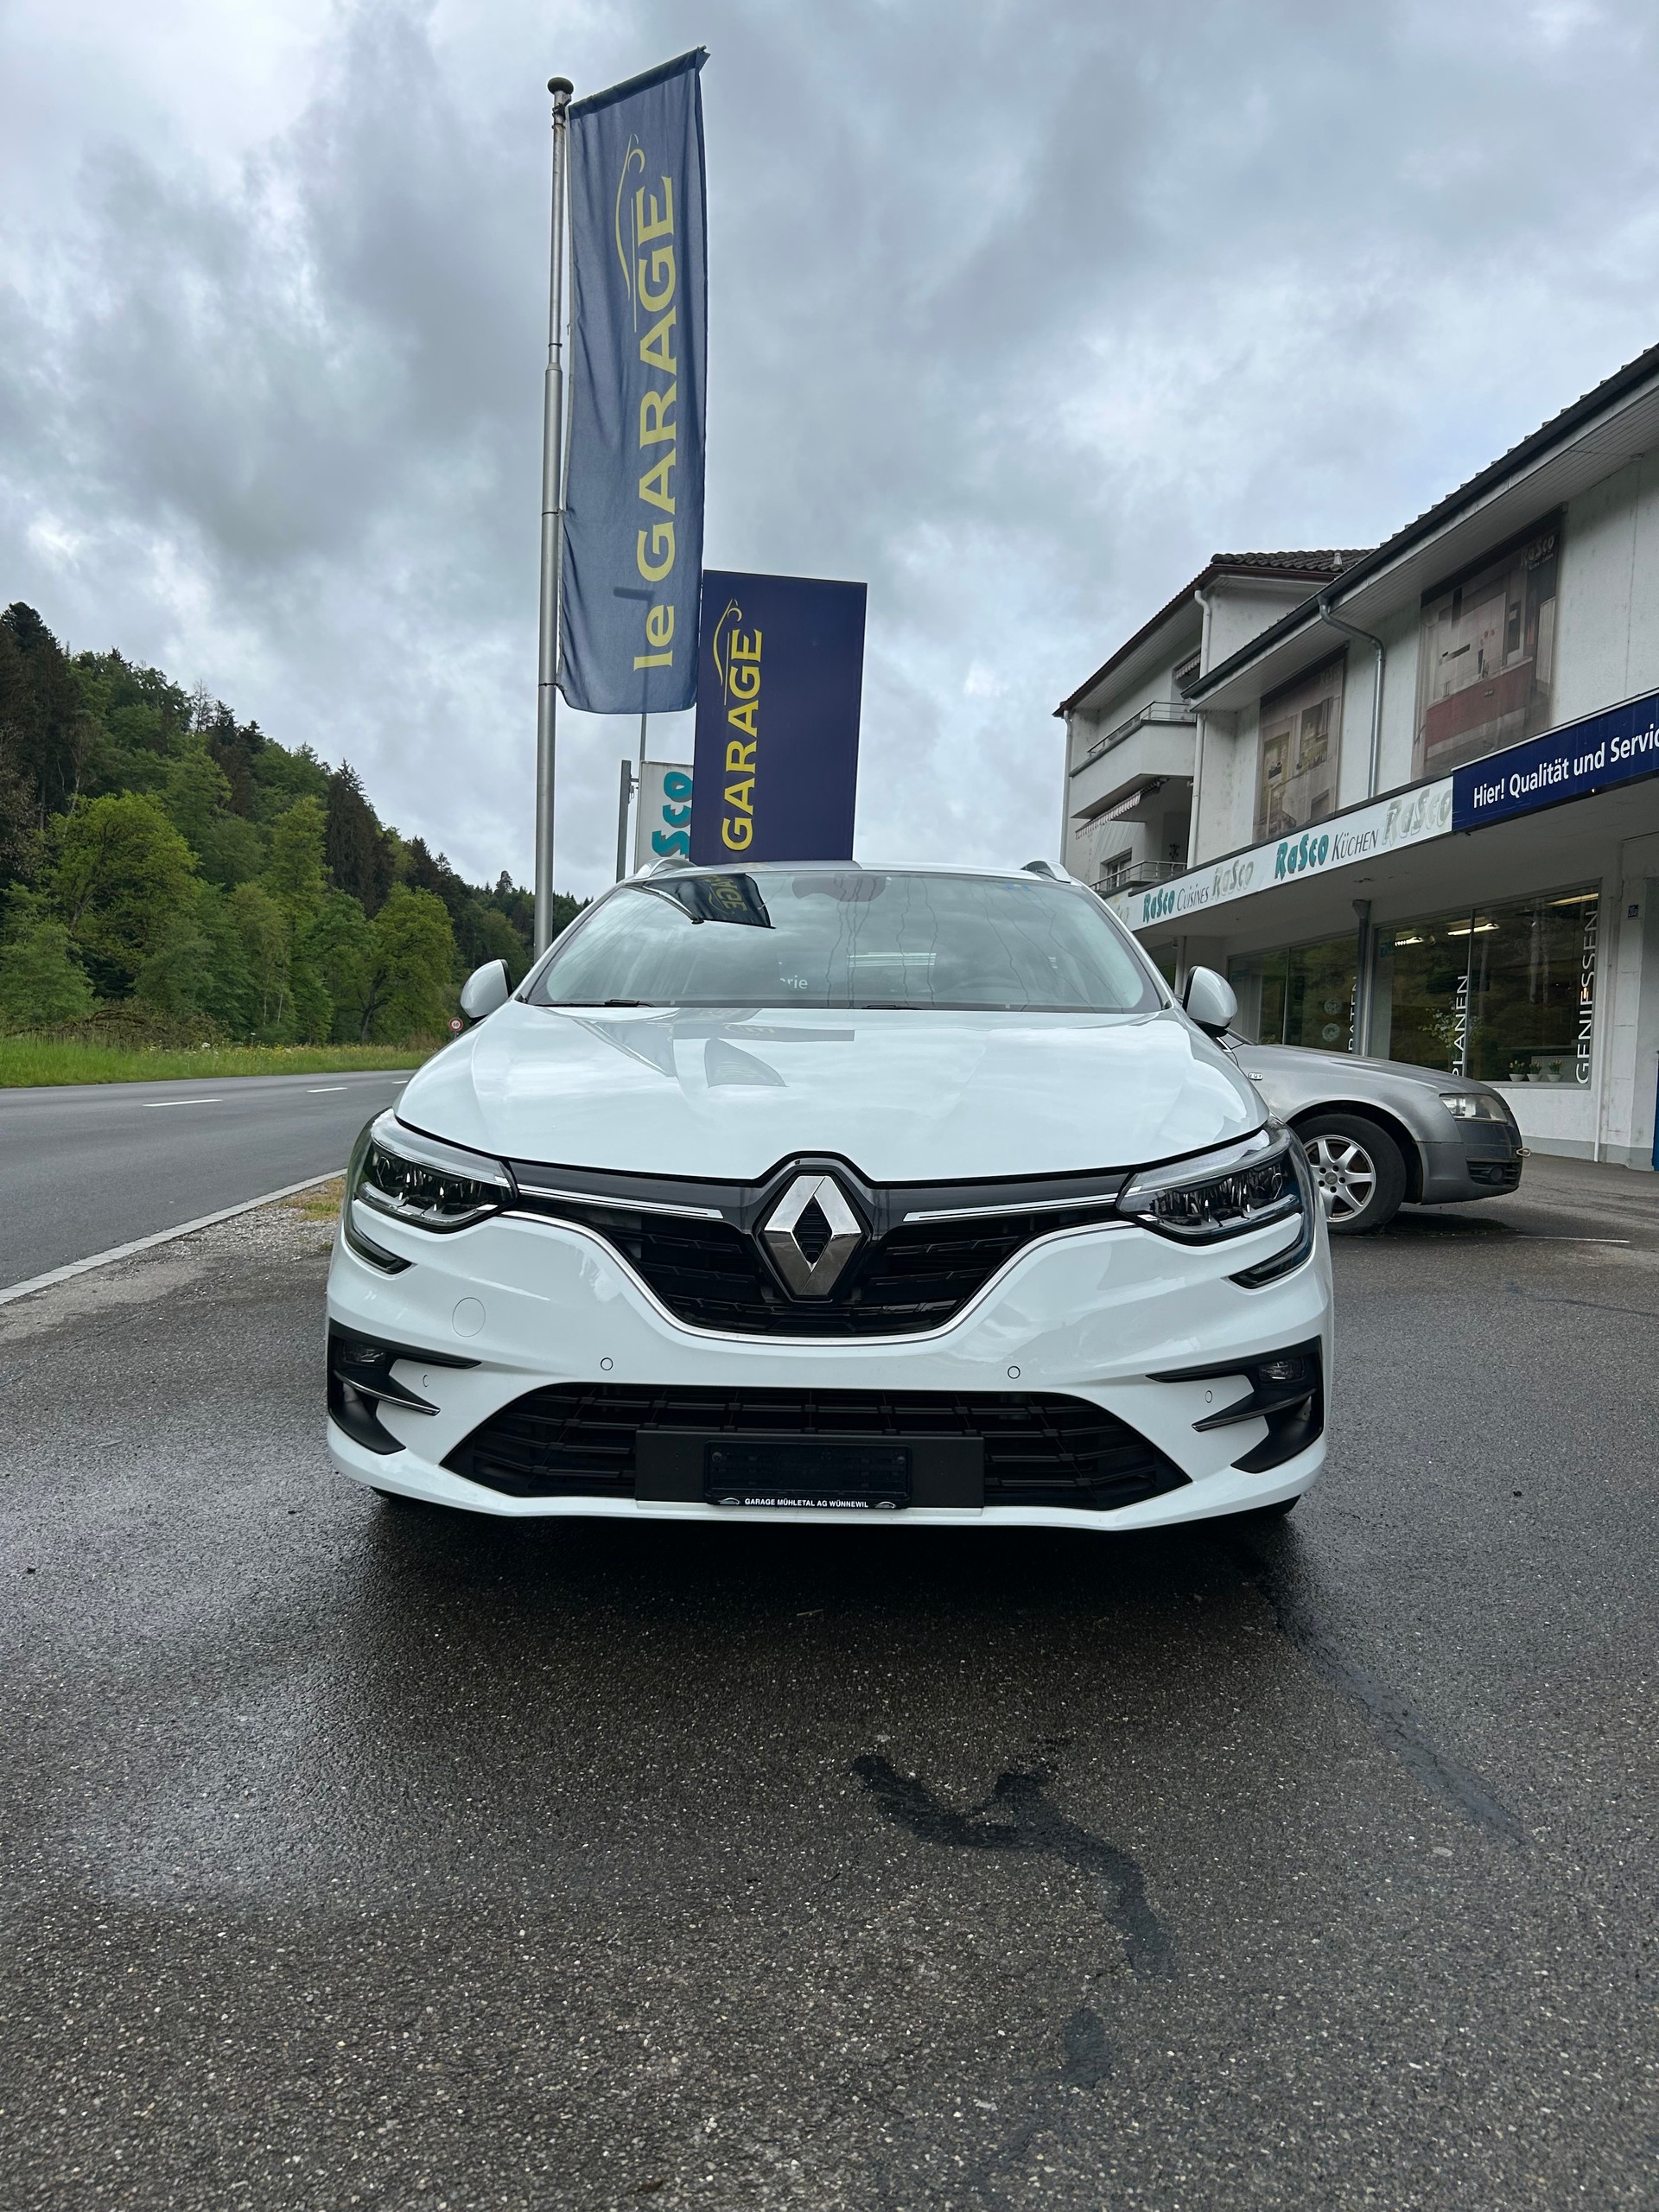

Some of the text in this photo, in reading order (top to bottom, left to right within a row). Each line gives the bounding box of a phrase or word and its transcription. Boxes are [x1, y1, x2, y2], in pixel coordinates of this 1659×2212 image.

[633, 175, 677, 672] le GARAGE
[721, 627, 763, 852] GARAGE
[1473, 778, 1505, 809] Hier!
[1509, 757, 1569, 798] Qualität
[1573, 742, 1605, 776] und
[778, 1498, 816, 1507] MÜHLETAL
[829, 1499, 868, 1509] WÜNNEWIL
